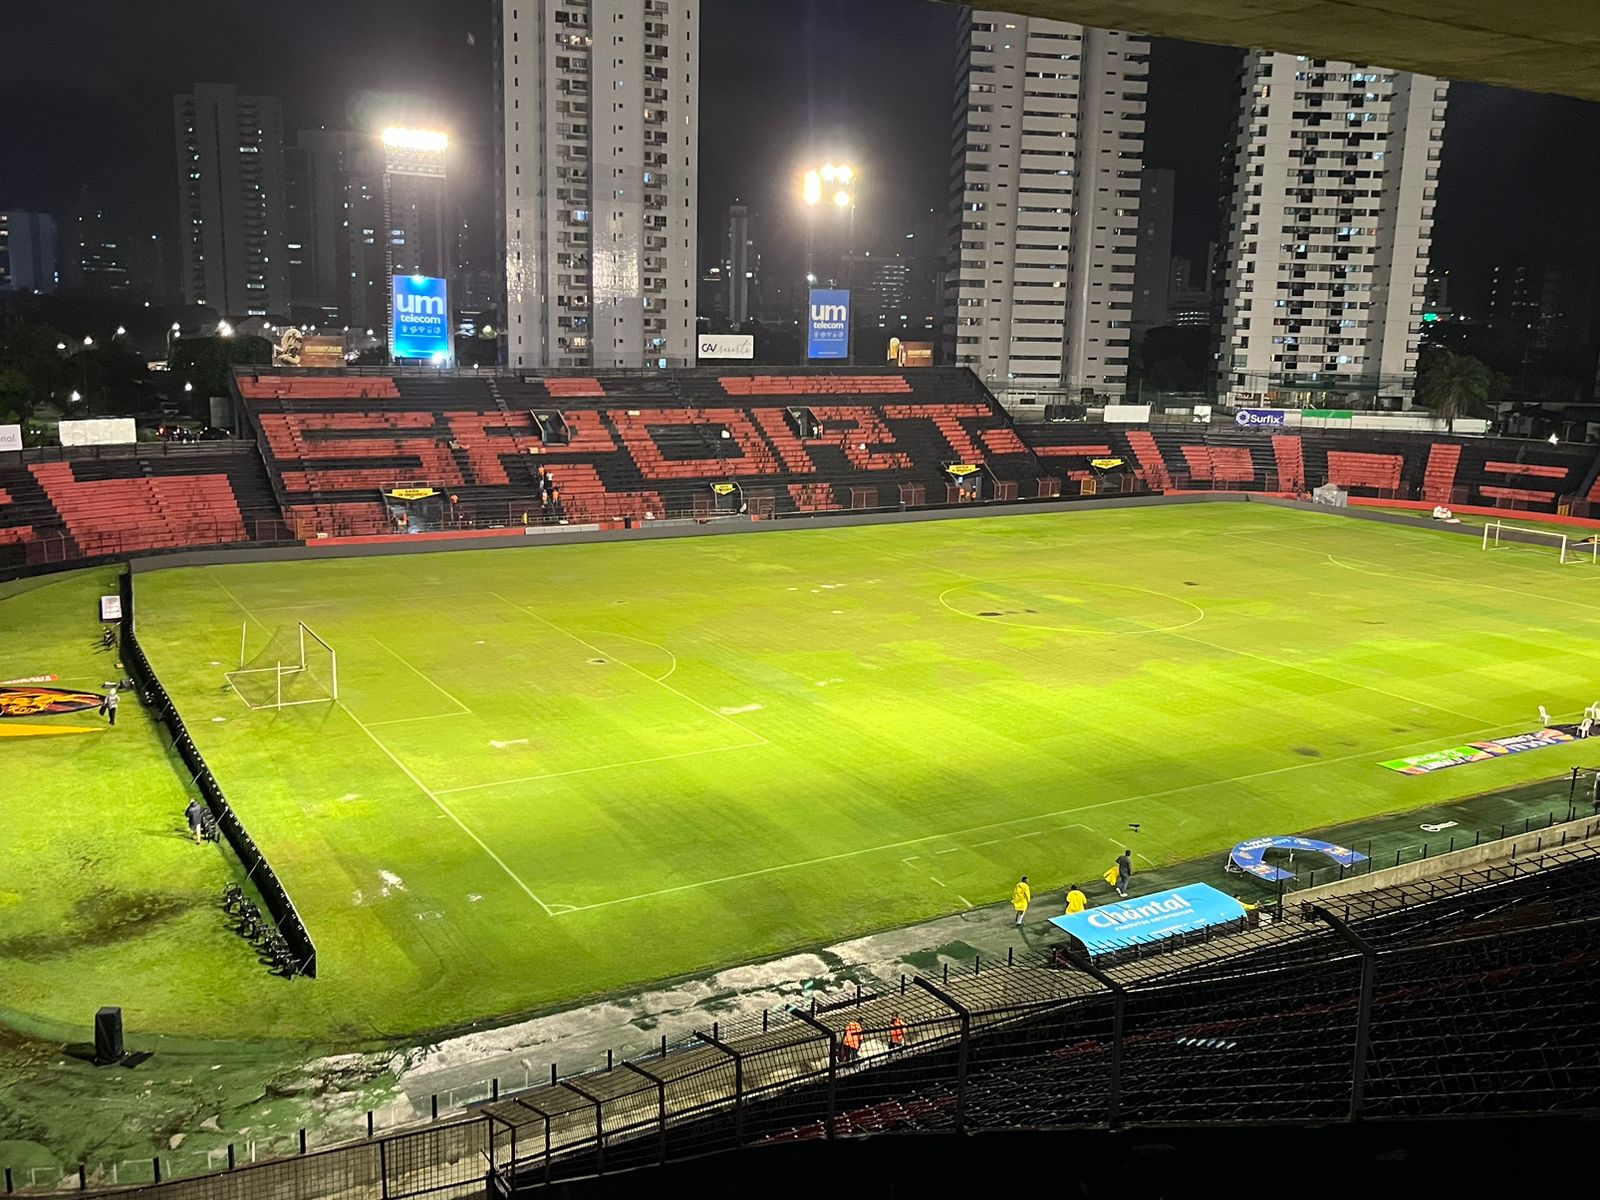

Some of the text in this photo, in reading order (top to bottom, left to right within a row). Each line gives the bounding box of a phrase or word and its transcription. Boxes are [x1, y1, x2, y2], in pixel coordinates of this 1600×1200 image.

[396, 293, 444, 315] um
[811, 304, 847, 321] um
[400, 314, 442, 325] telecom
[813, 321, 844, 330] telecom
[1250, 414, 1281, 424] Surfix
[258, 404, 993, 493] SPORT
[1087, 893, 1192, 928] Chantal
